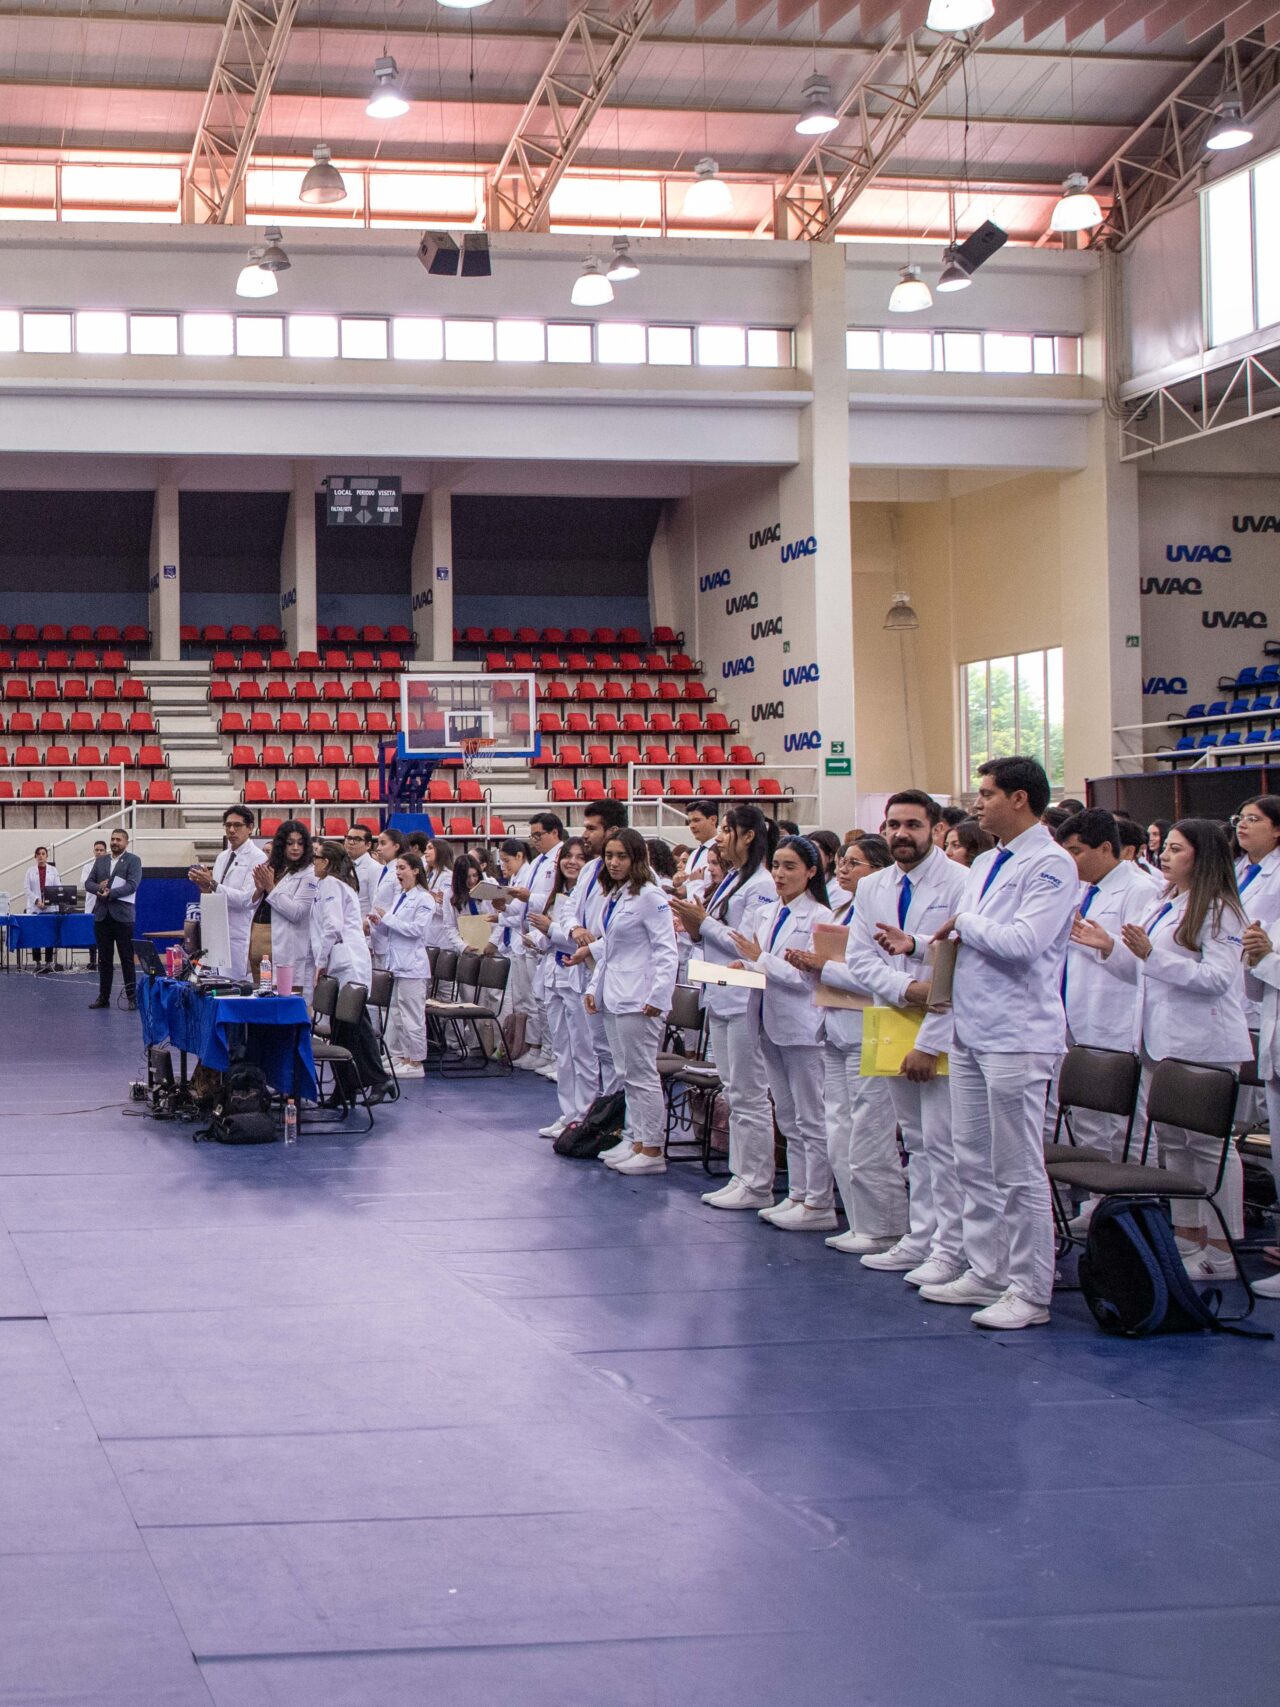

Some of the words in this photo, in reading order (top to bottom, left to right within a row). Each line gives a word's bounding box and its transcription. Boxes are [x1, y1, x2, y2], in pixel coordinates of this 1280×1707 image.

[1232, 515, 1280, 533] UVA
[780, 536, 818, 563] UVAQ
[1166, 544, 1232, 563] UVAQ
[699, 568, 731, 593] UVAQ
[1140, 577, 1203, 595] UVAQ
[725, 591, 759, 616] UVAQ
[1202, 611, 1268, 629] UVAQ
[722, 655, 755, 679] UVAQ
[782, 662, 820, 687] UVAQ
[1141, 676, 1188, 695] VAQ
[751, 700, 784, 722] UVAQ
[783, 729, 822, 753] UVAQ
